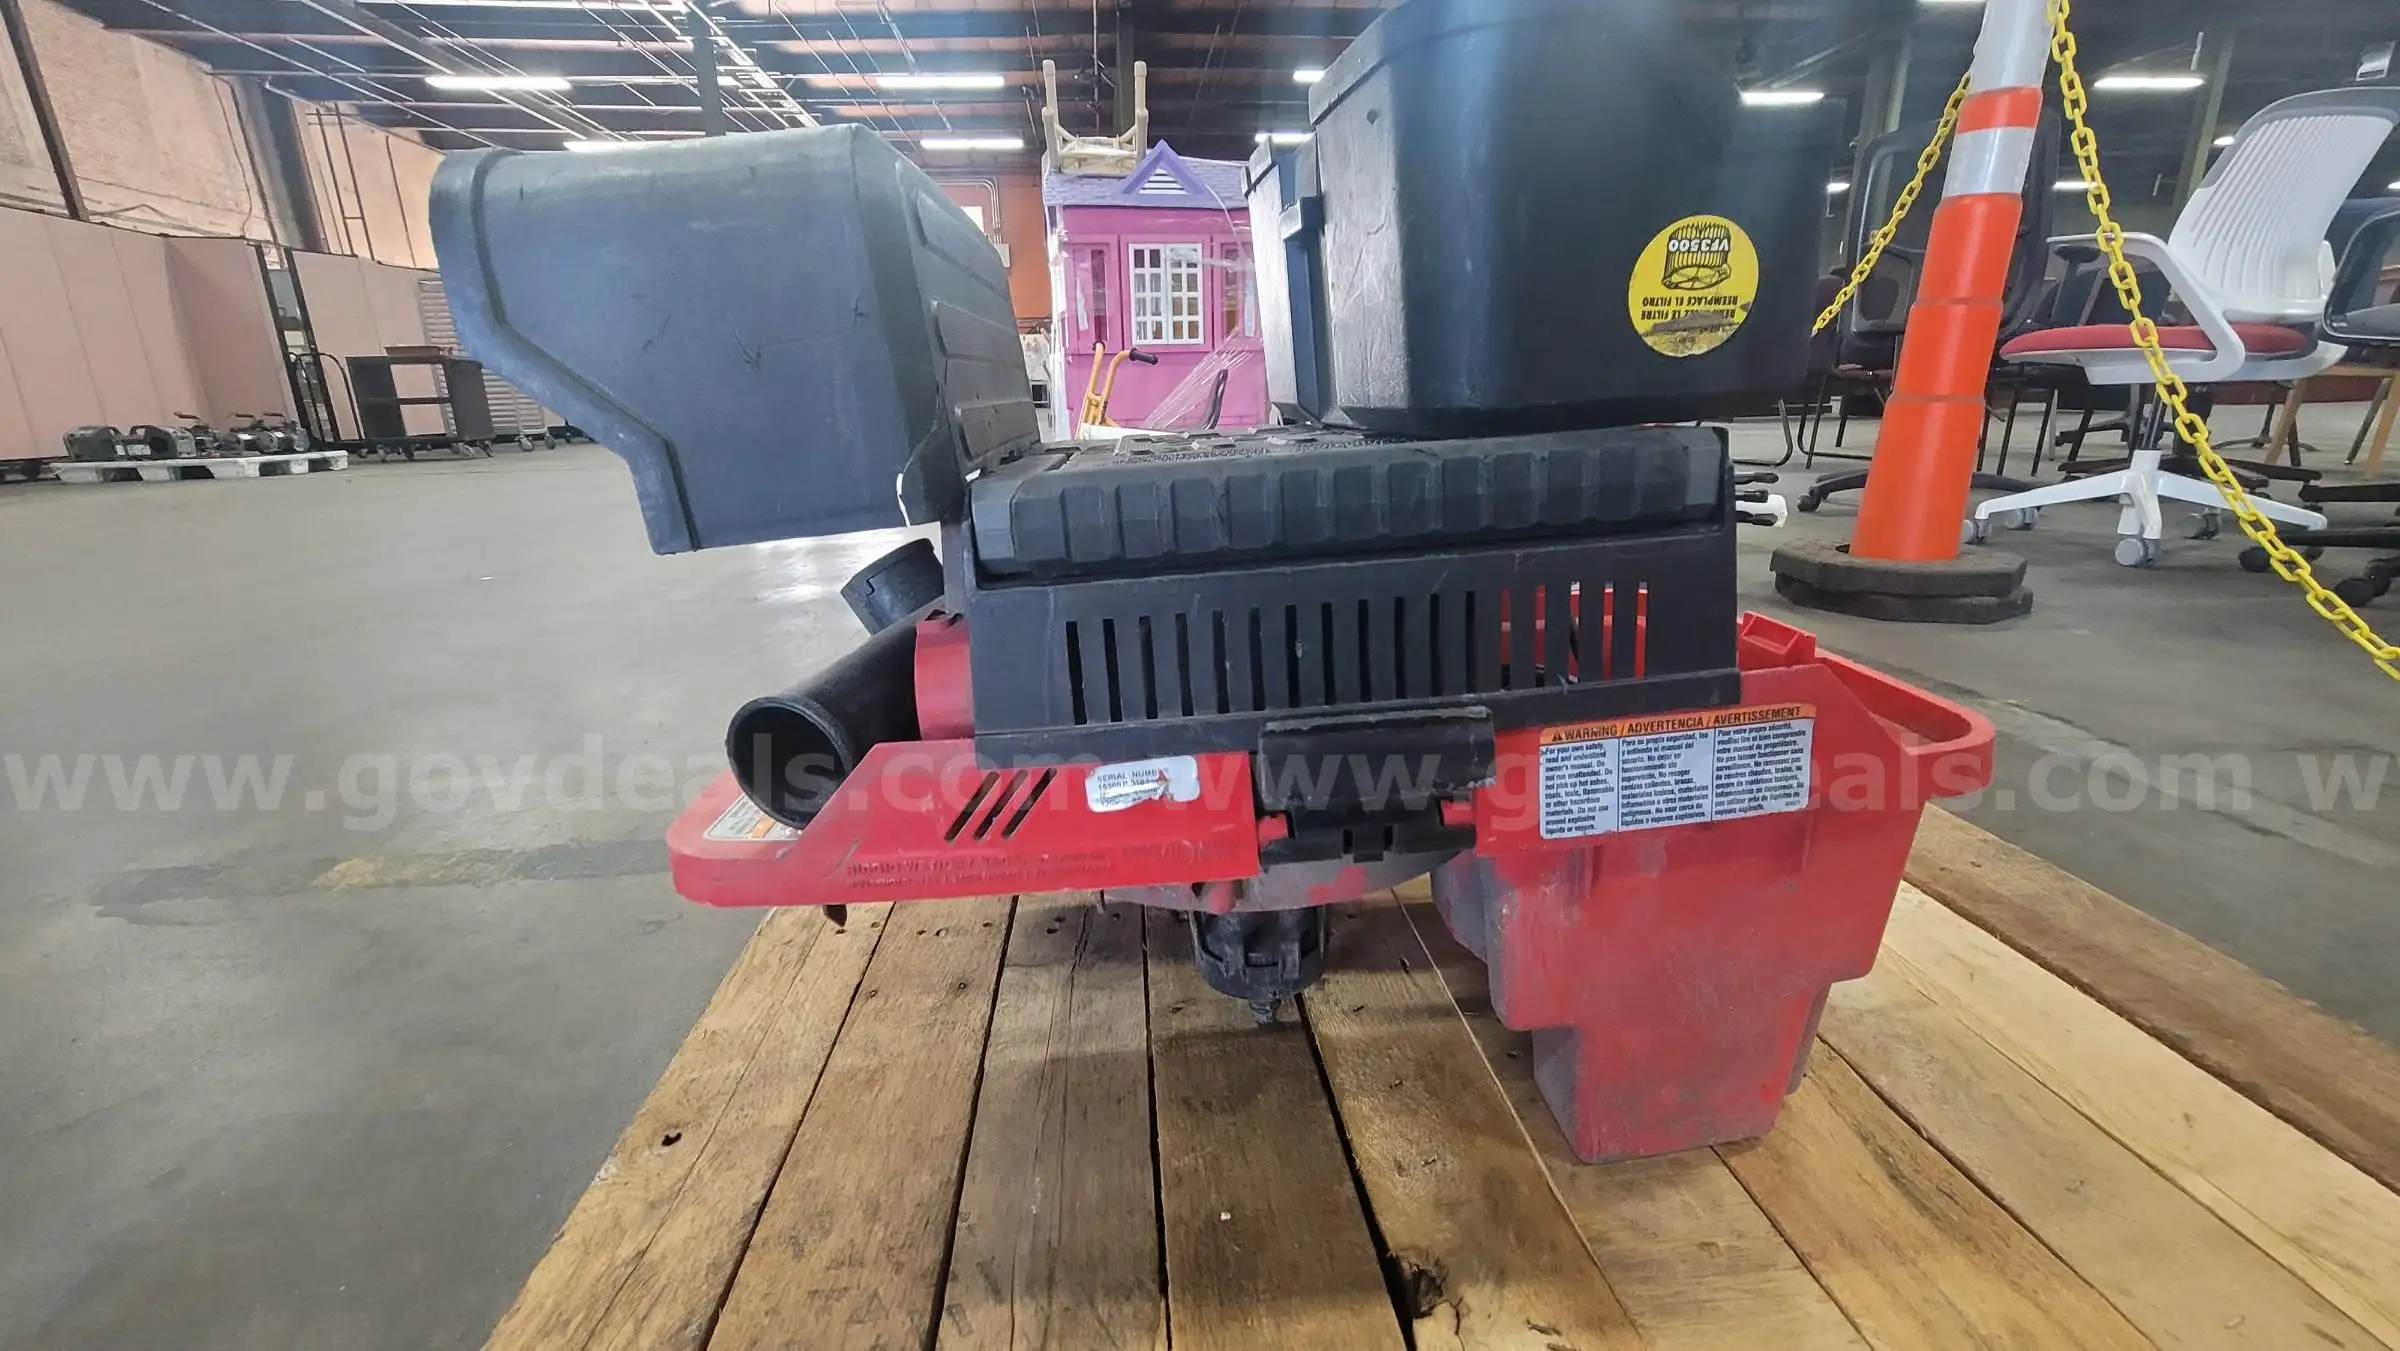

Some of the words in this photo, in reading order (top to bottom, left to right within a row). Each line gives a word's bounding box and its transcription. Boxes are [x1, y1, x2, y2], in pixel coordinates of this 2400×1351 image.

[1668, 238, 1729, 252] VF3500
[1642, 296, 1672, 308] FILTRO
[1675, 296, 1685, 307] EL
[1687, 295, 1738, 307] REEMPLACE
[1565, 724, 1618, 740] WARNING
[1628, 717, 1704, 734] ADVERTENCIA
[1714, 706, 1800, 725] AVERTISSEMENT
[1097, 771, 1127, 783] SERIAL
